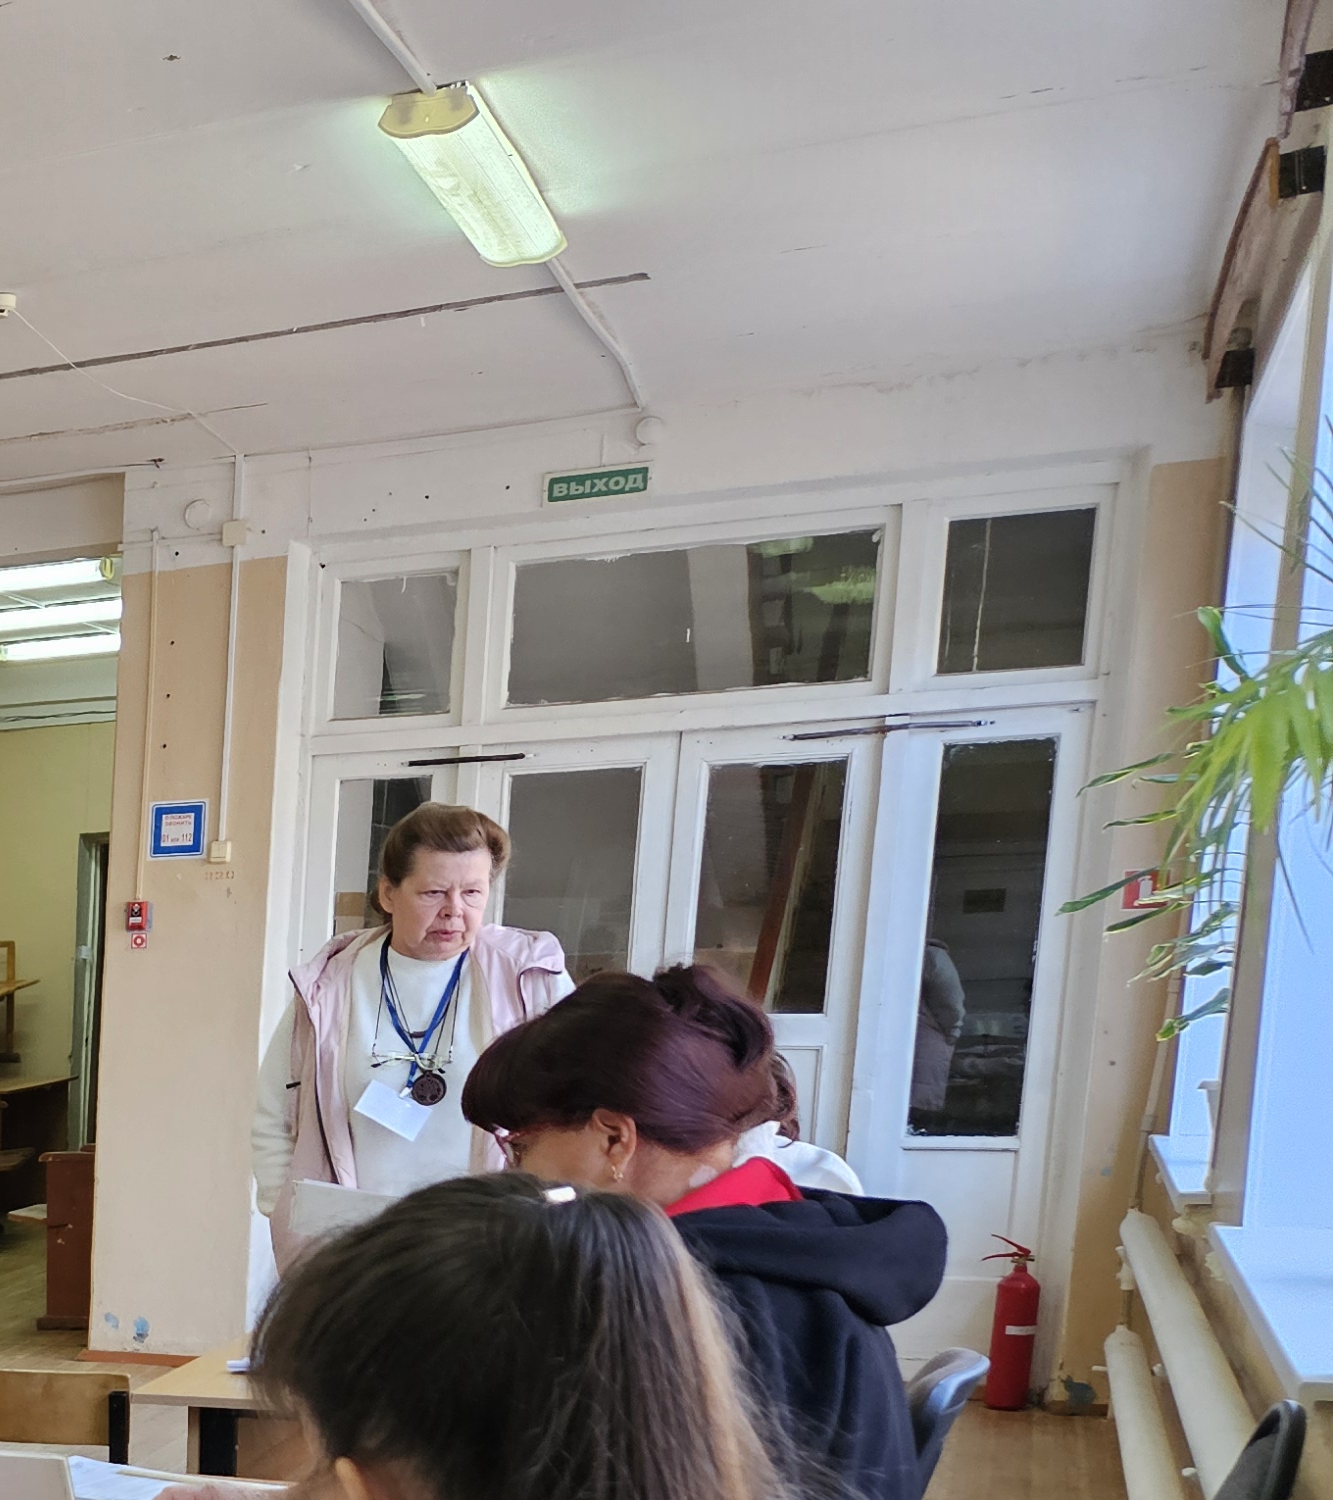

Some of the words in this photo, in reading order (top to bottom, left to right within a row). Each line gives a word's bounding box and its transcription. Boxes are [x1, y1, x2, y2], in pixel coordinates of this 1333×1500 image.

[552, 473, 645, 498] ВЫХОД
[162, 834, 169, 843] 01
[181, 833, 192, 842] 112
